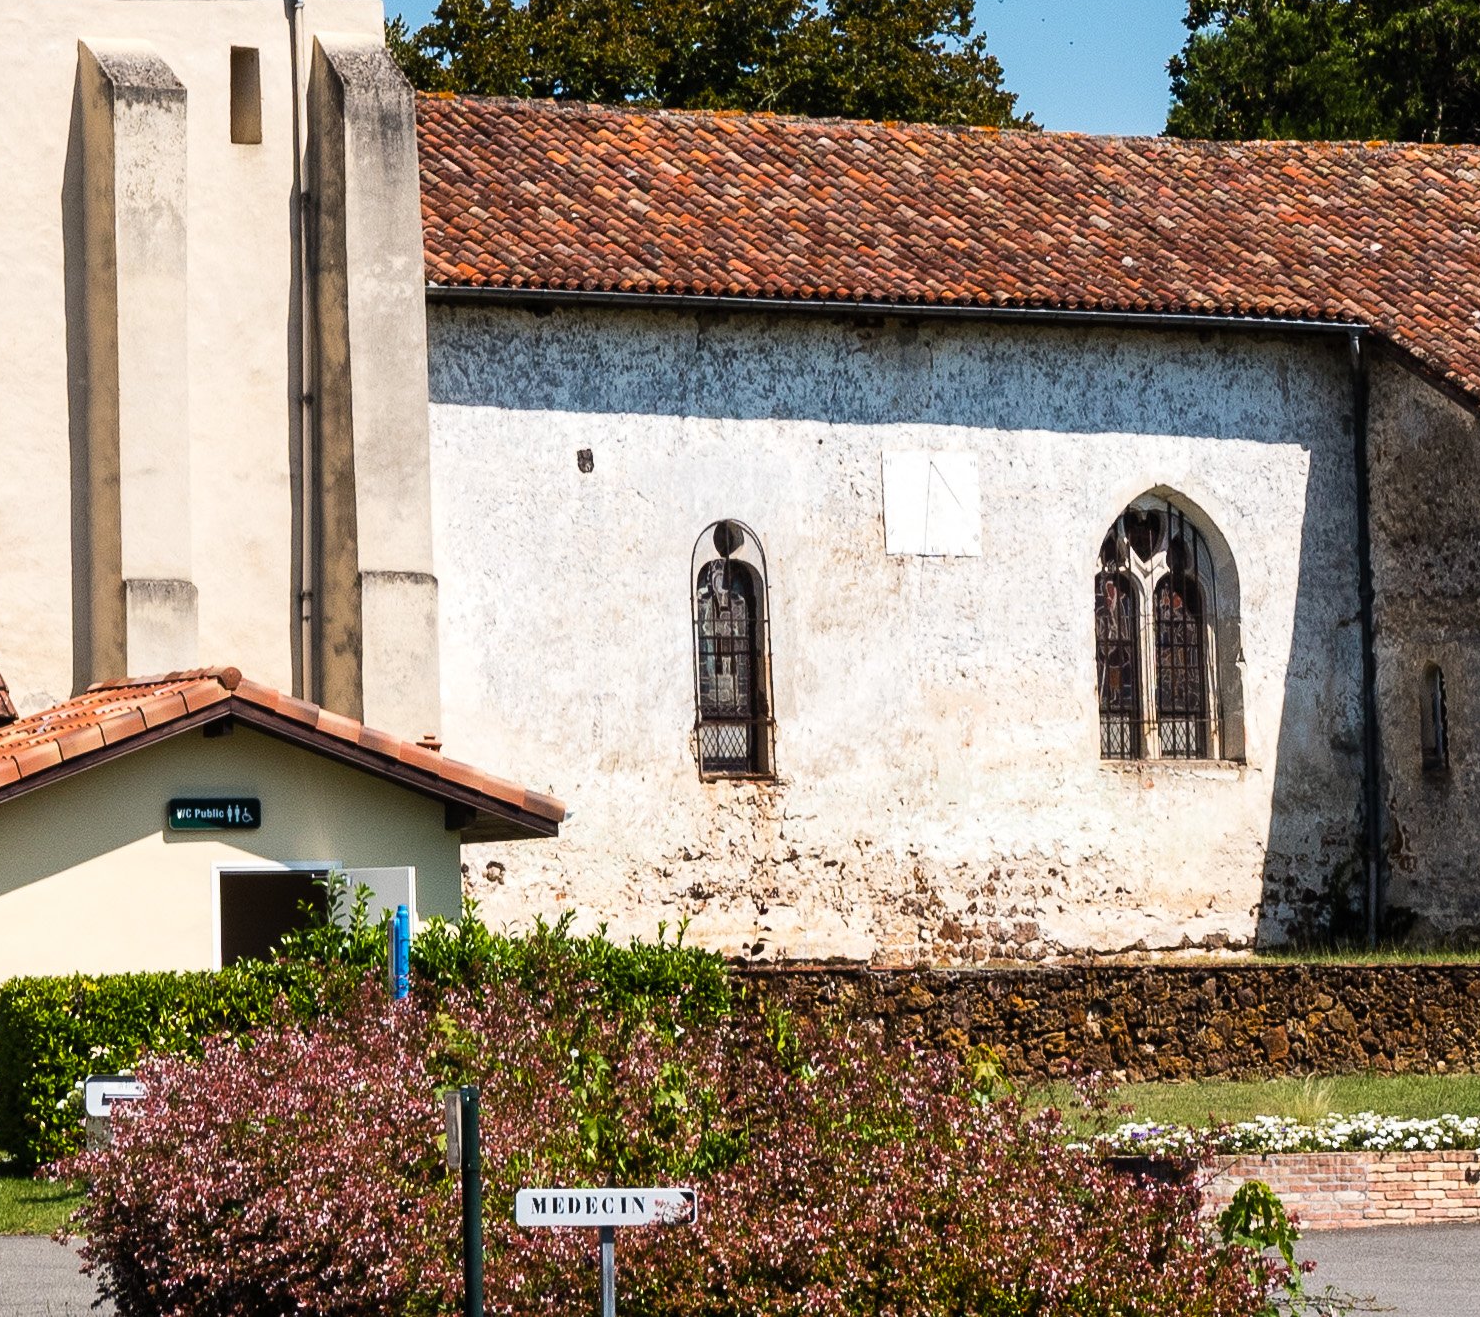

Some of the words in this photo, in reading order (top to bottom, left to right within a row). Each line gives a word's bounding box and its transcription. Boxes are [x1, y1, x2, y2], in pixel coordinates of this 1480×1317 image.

[177, 808, 192, 819] WC
[194, 808, 224, 819] Public
[531, 1196, 645, 1215] MEDECIN
